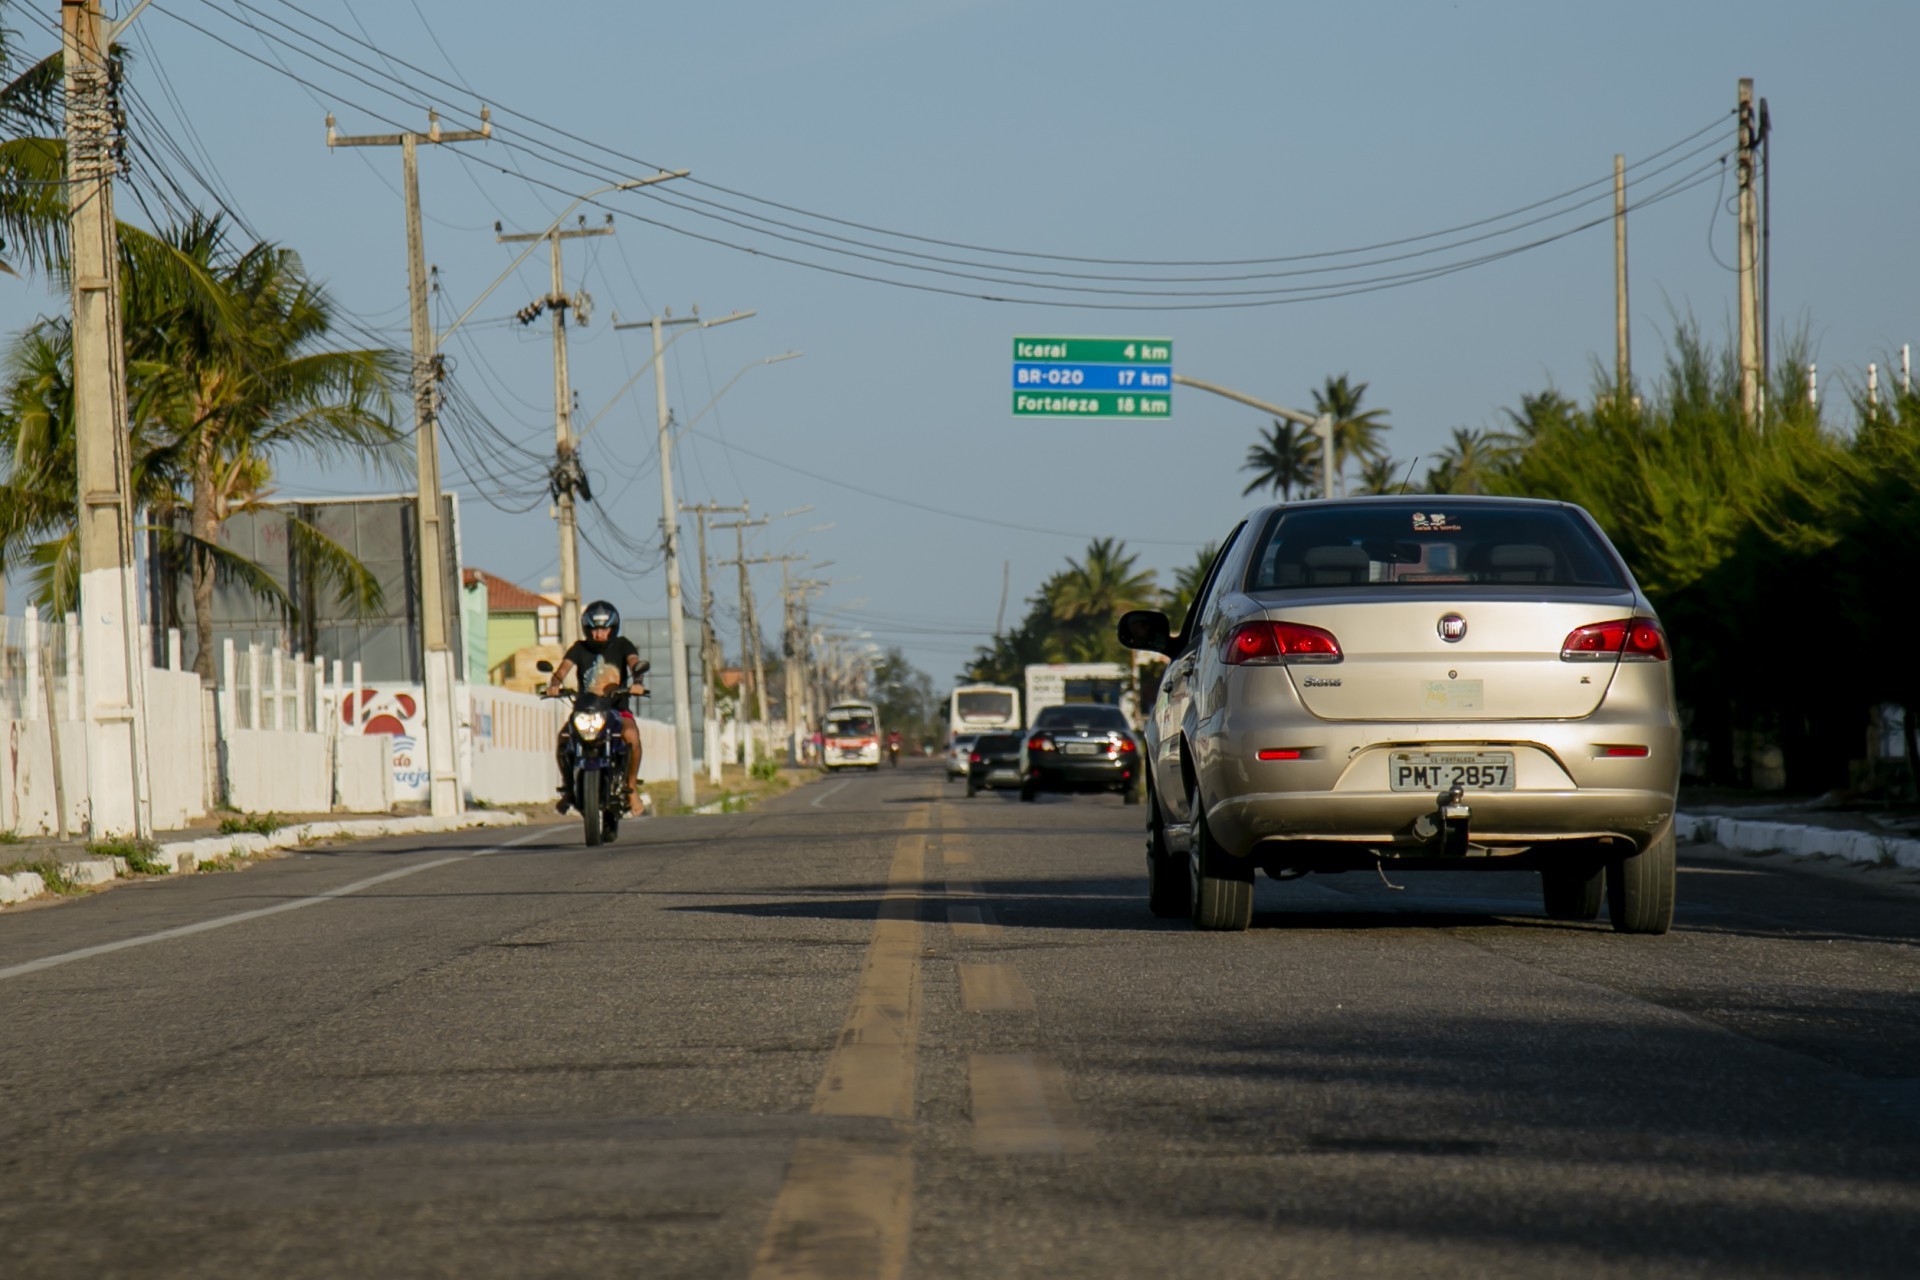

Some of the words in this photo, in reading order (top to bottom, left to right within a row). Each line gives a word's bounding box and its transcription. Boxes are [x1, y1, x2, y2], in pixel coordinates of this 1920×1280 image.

[1124, 344, 1136, 359] 4
[1141, 345, 1168, 360] km
[1017, 368, 1084, 385] BR-020
[1118, 370, 1136, 386] 17
[1140, 371, 1168, 386] km
[1017, 395, 1100, 412] Fortaleza
[1117, 397, 1136, 412] 18
[1140, 398, 1167, 413] km
[1303, 676, 1342, 687] Siena
